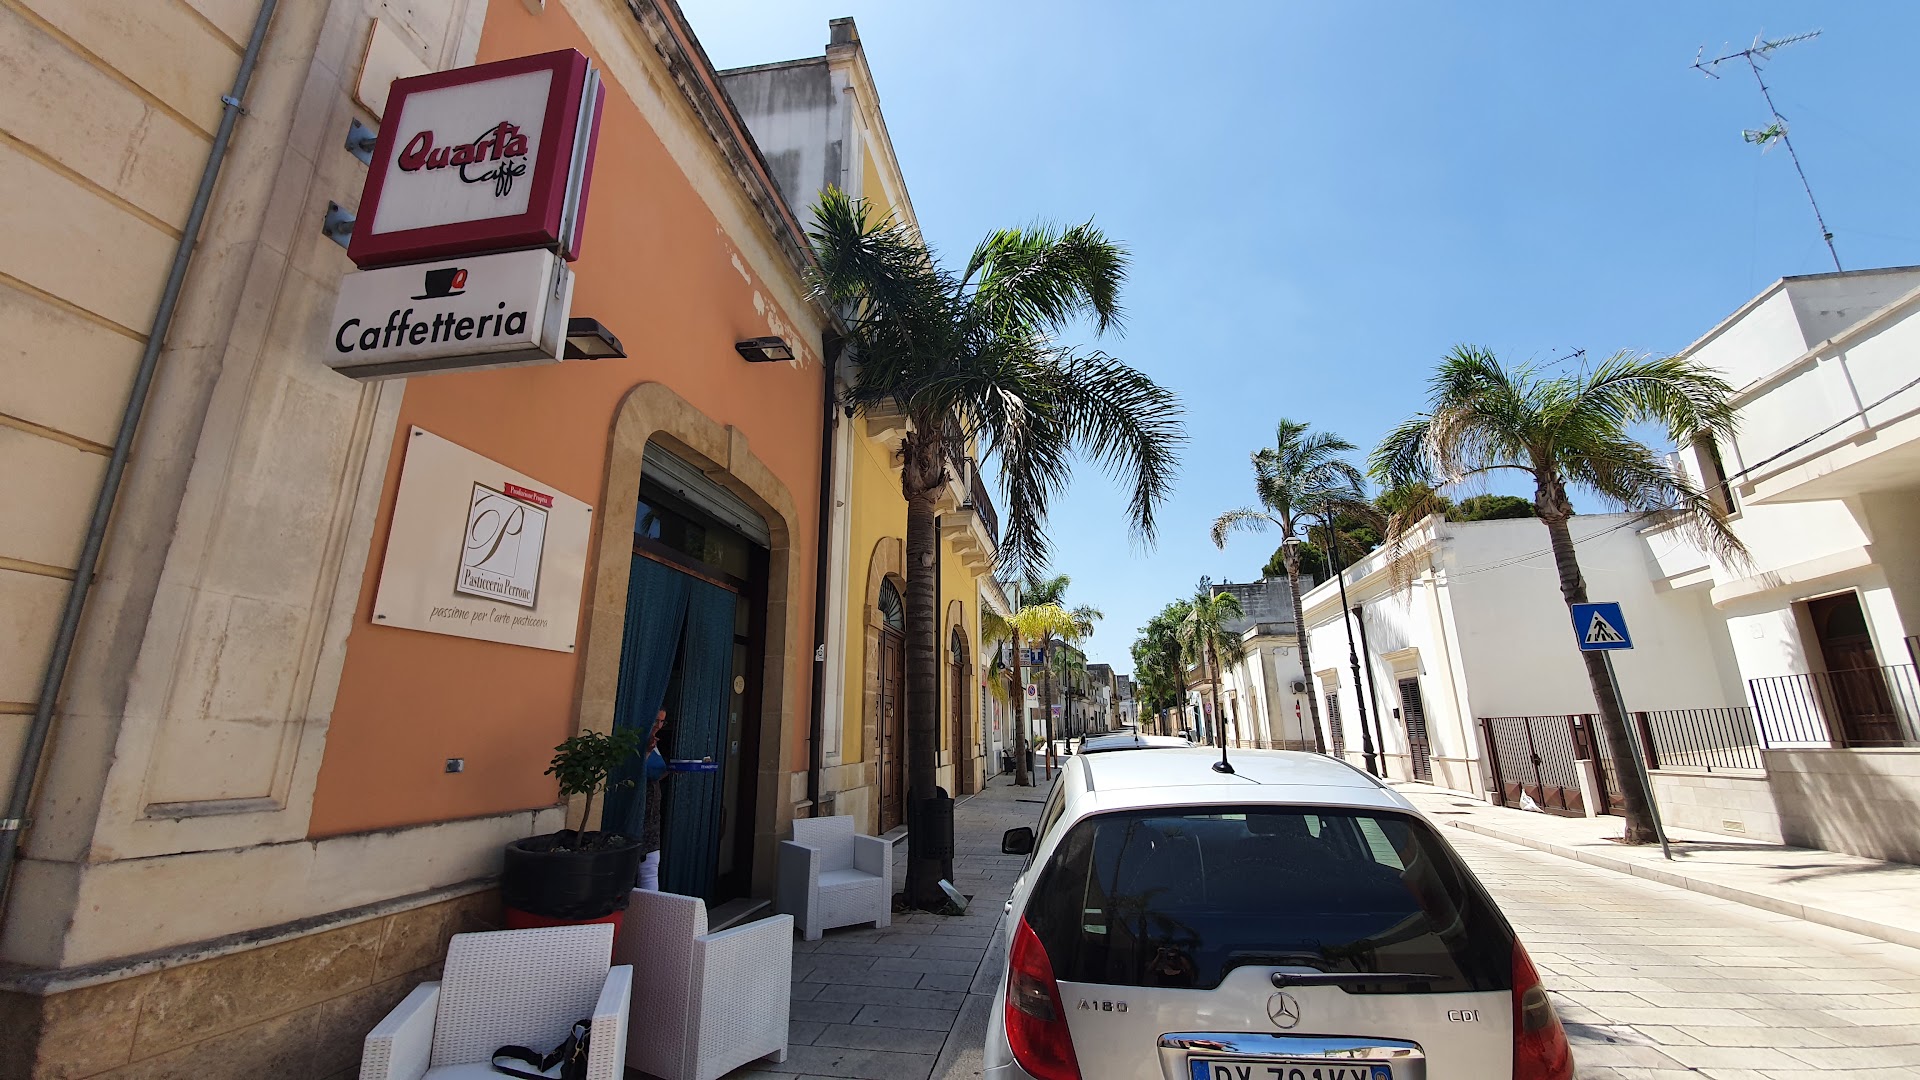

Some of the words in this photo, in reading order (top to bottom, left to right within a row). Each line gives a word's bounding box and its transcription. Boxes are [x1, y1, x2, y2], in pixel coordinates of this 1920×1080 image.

[398, 121, 530, 172] Quarta
[335, 302, 528, 353] Caffetteria
[463, 568, 504, 594] Pasticceria
[504, 579, 531, 600] Perrone
[429, 606, 470, 623] passione
[471, 610, 488, 625] per
[511, 614, 548, 629] pasticcera
[1447, 1009, 1480, 1022] CDI
